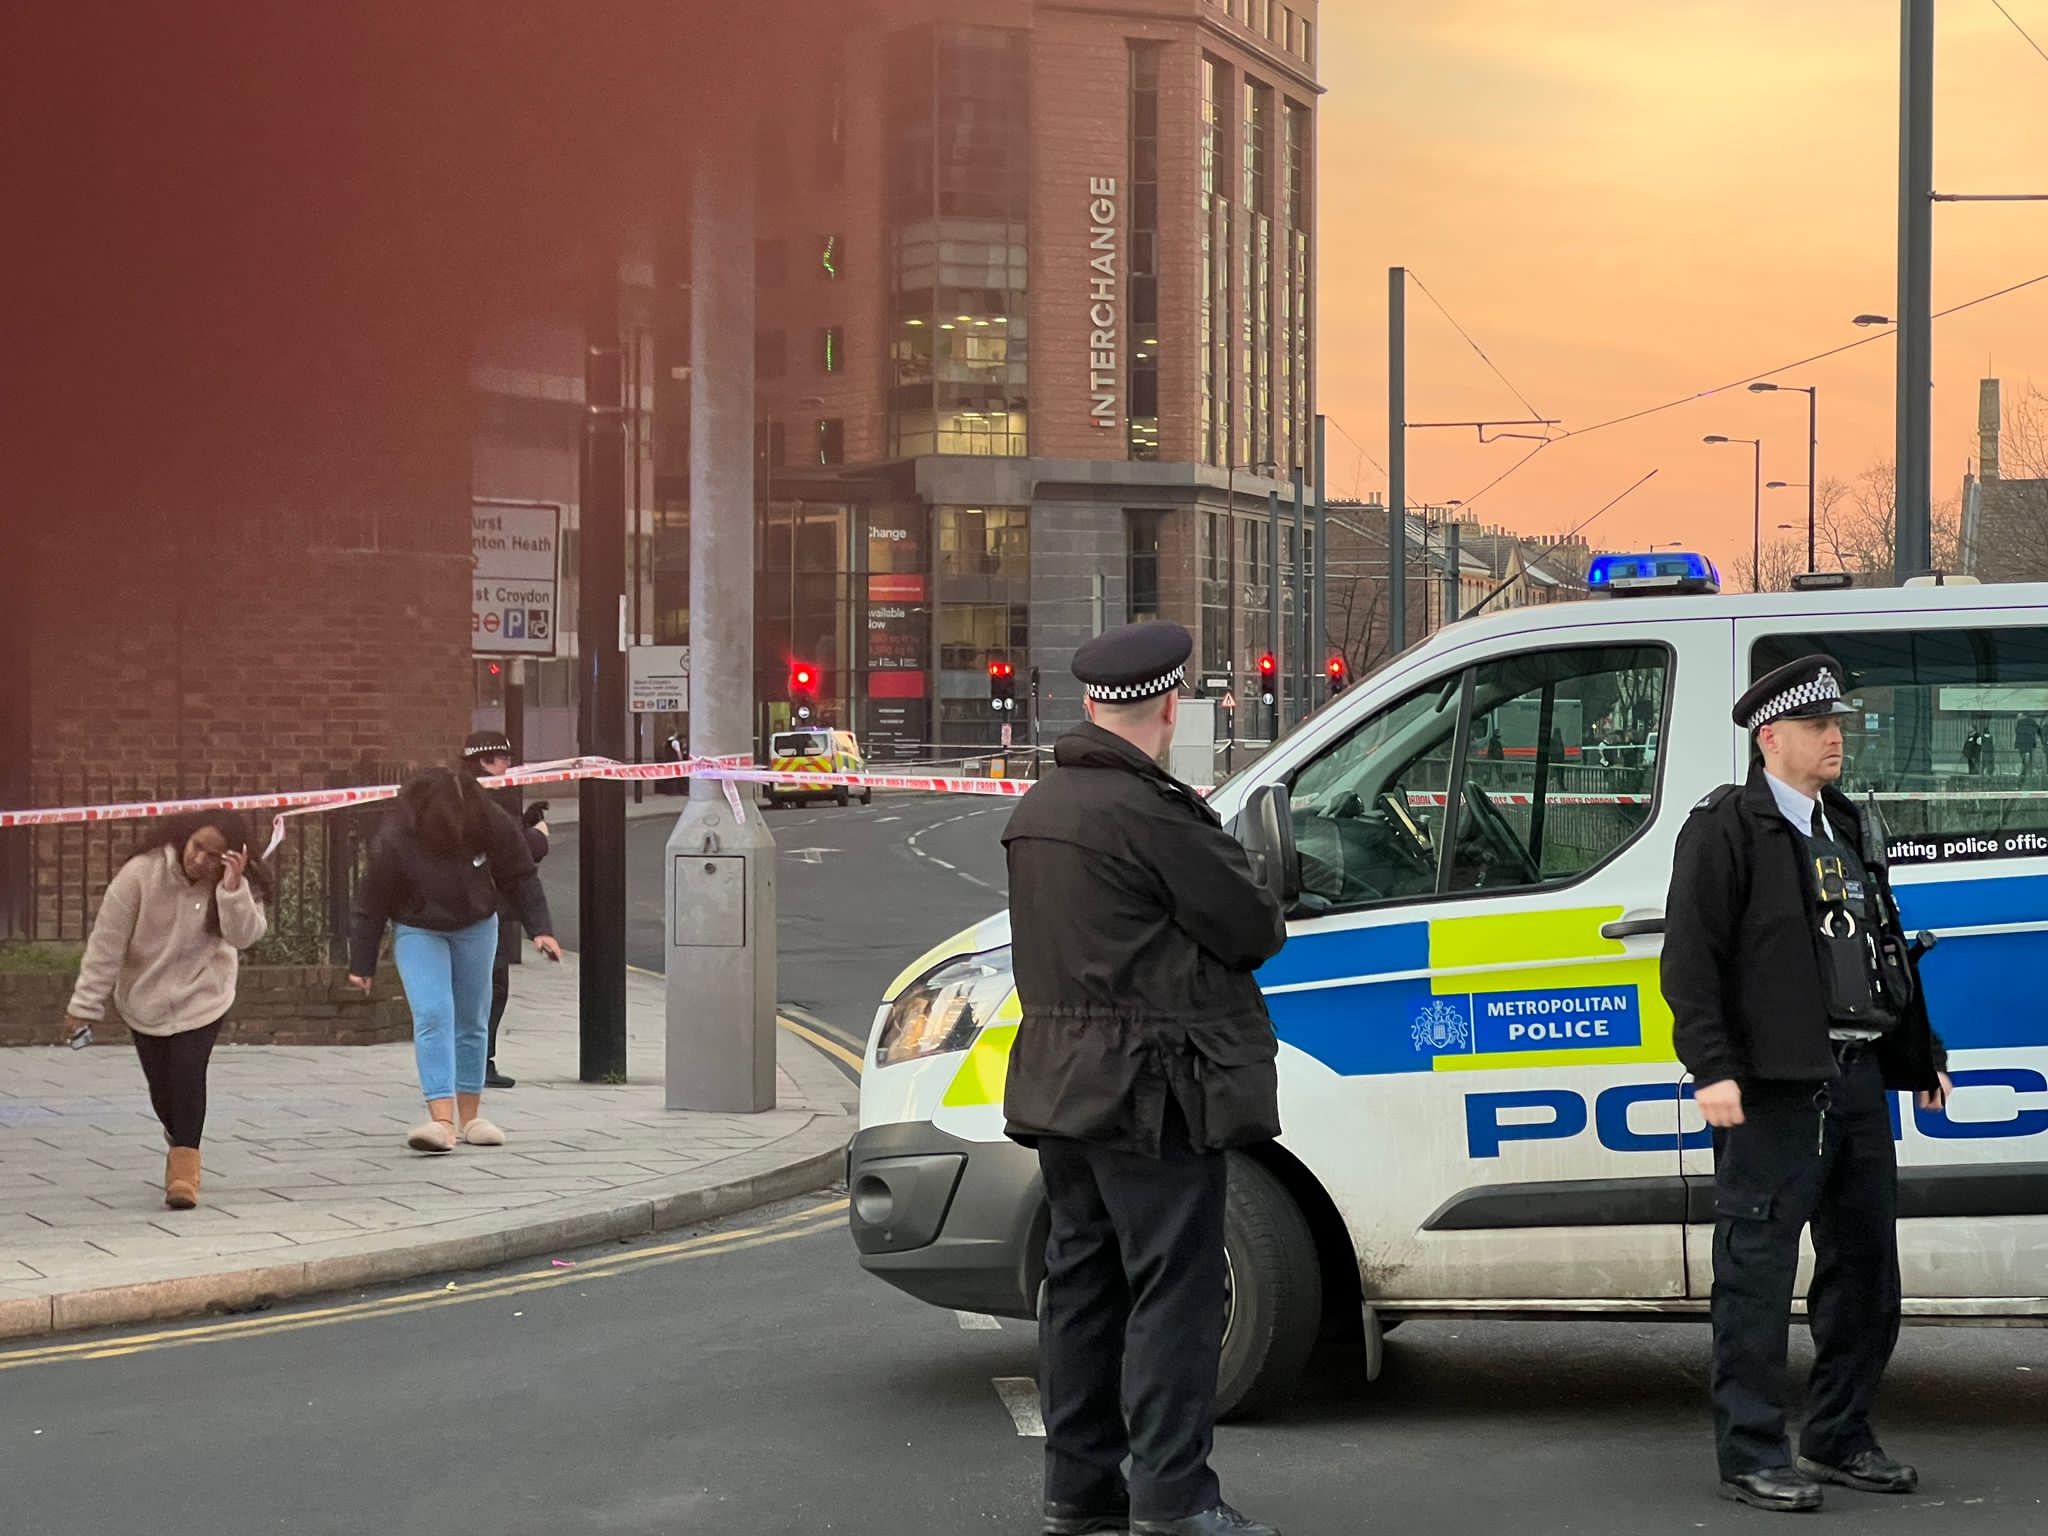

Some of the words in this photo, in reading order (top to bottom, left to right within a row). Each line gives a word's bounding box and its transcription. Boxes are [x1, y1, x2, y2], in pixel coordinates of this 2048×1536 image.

[512, 536, 551, 552] Heath
[496, 588, 550, 604] Croydon
[1887, 841, 1937, 860] uiting
[1943, 837, 1999, 858] police
[2004, 833, 2048, 851] offic
[1487, 996, 1627, 1017] METROPOLITAN
[1508, 1020, 1610, 1041] POLICE
